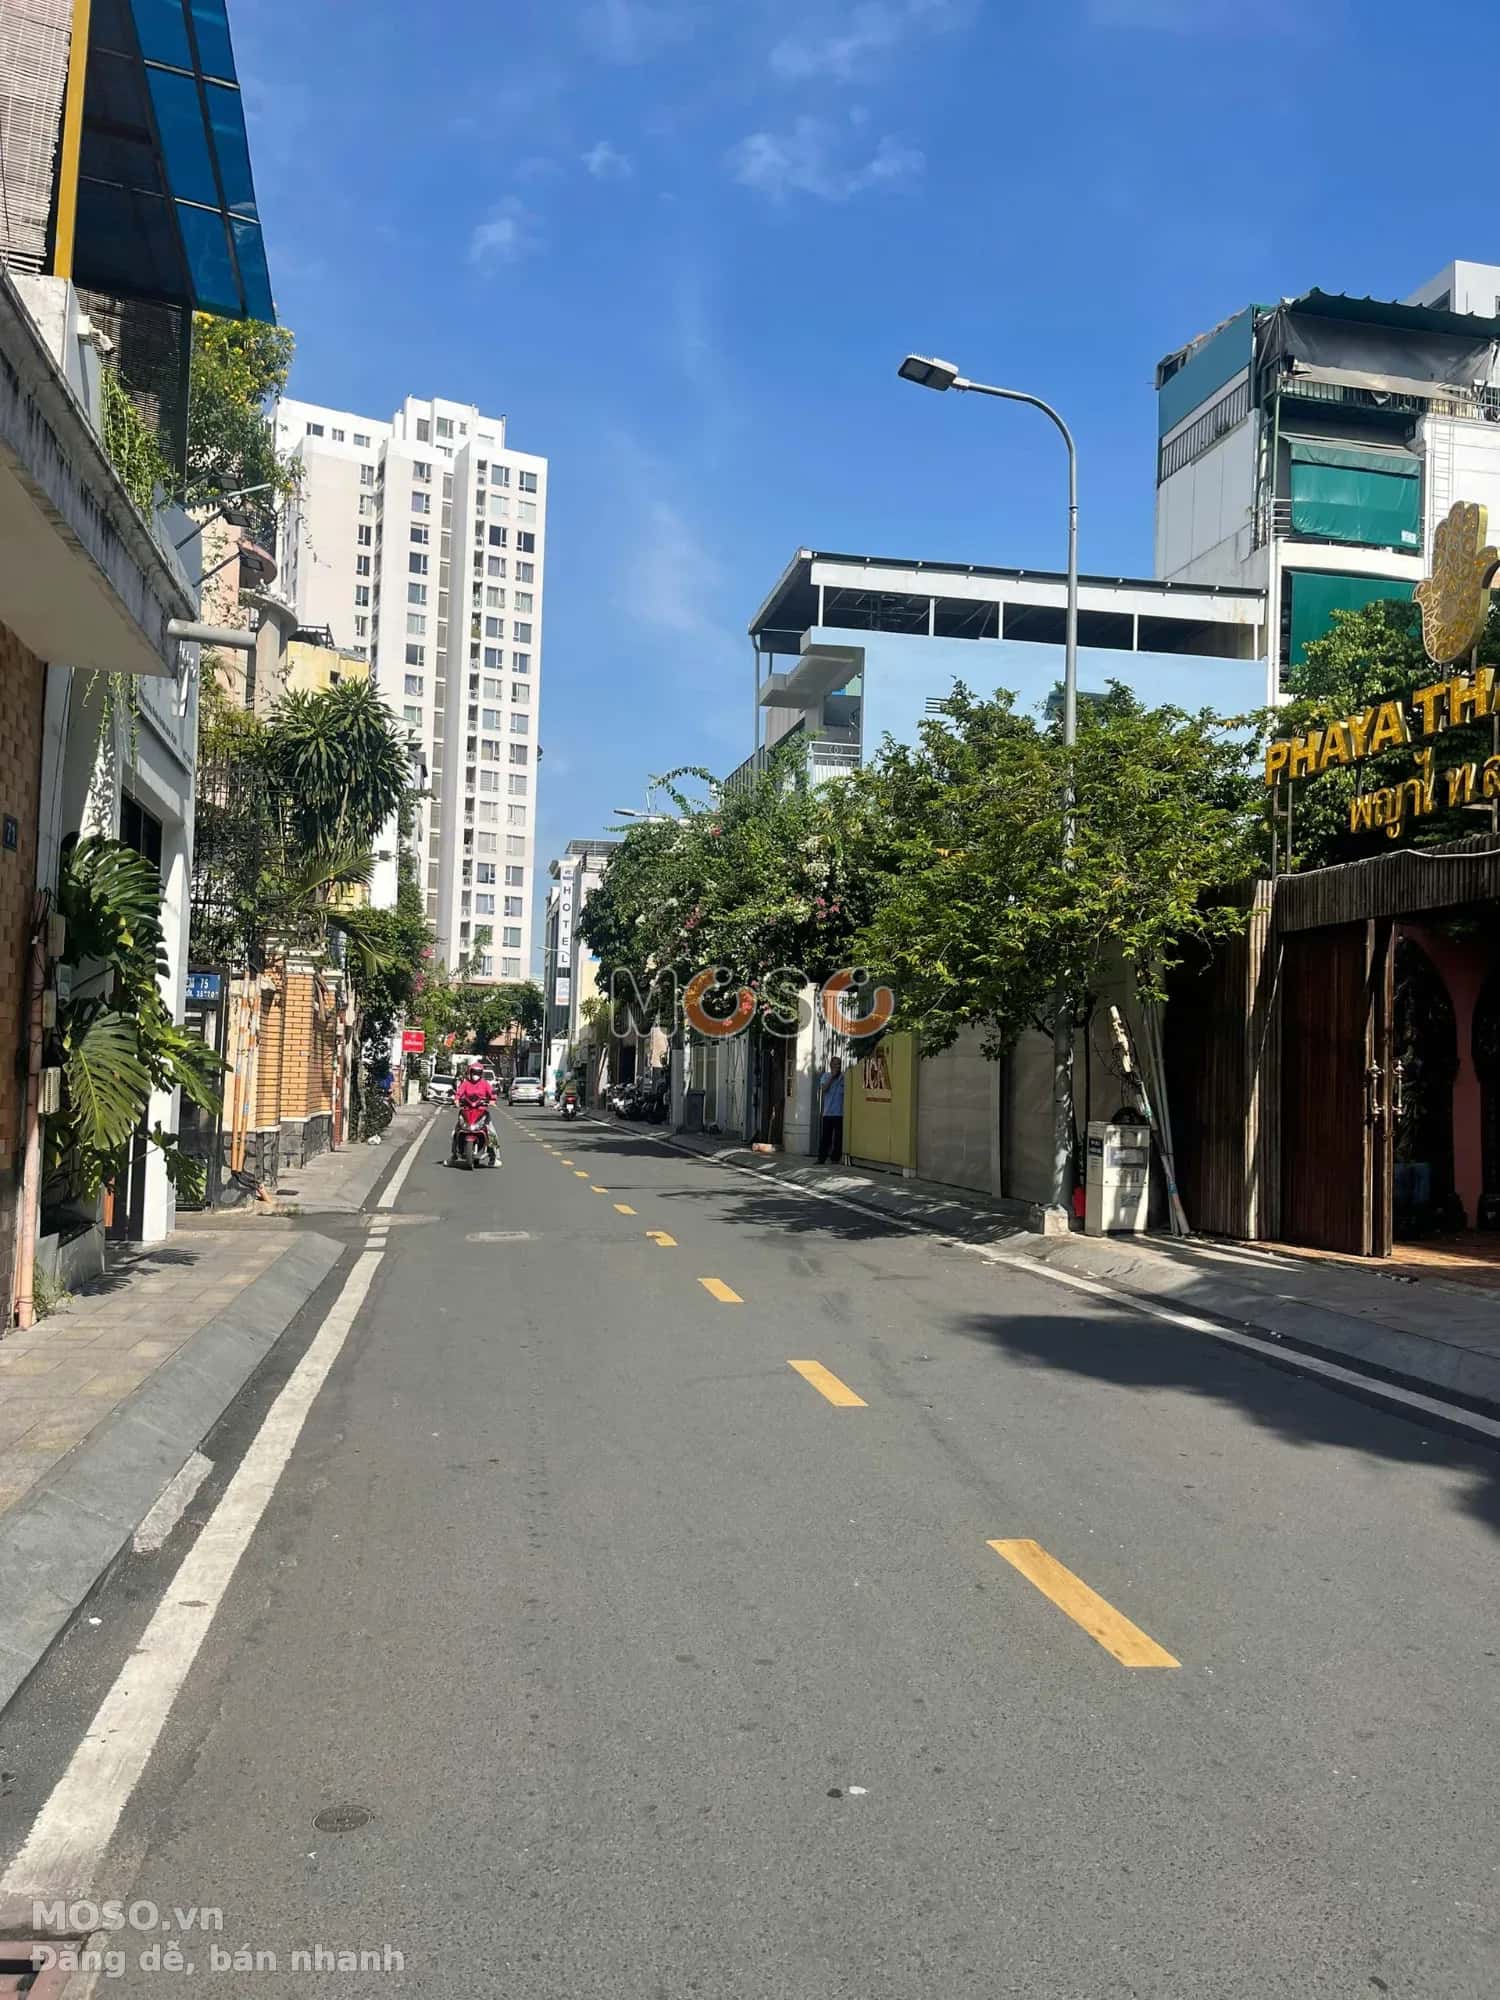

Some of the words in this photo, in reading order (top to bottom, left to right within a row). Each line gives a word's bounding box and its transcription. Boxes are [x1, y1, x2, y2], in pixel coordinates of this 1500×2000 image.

[1266, 701, 1411, 786] PHAYA
[1413, 667, 1500, 735] TH
[561, 886, 572, 963] HOTEL
